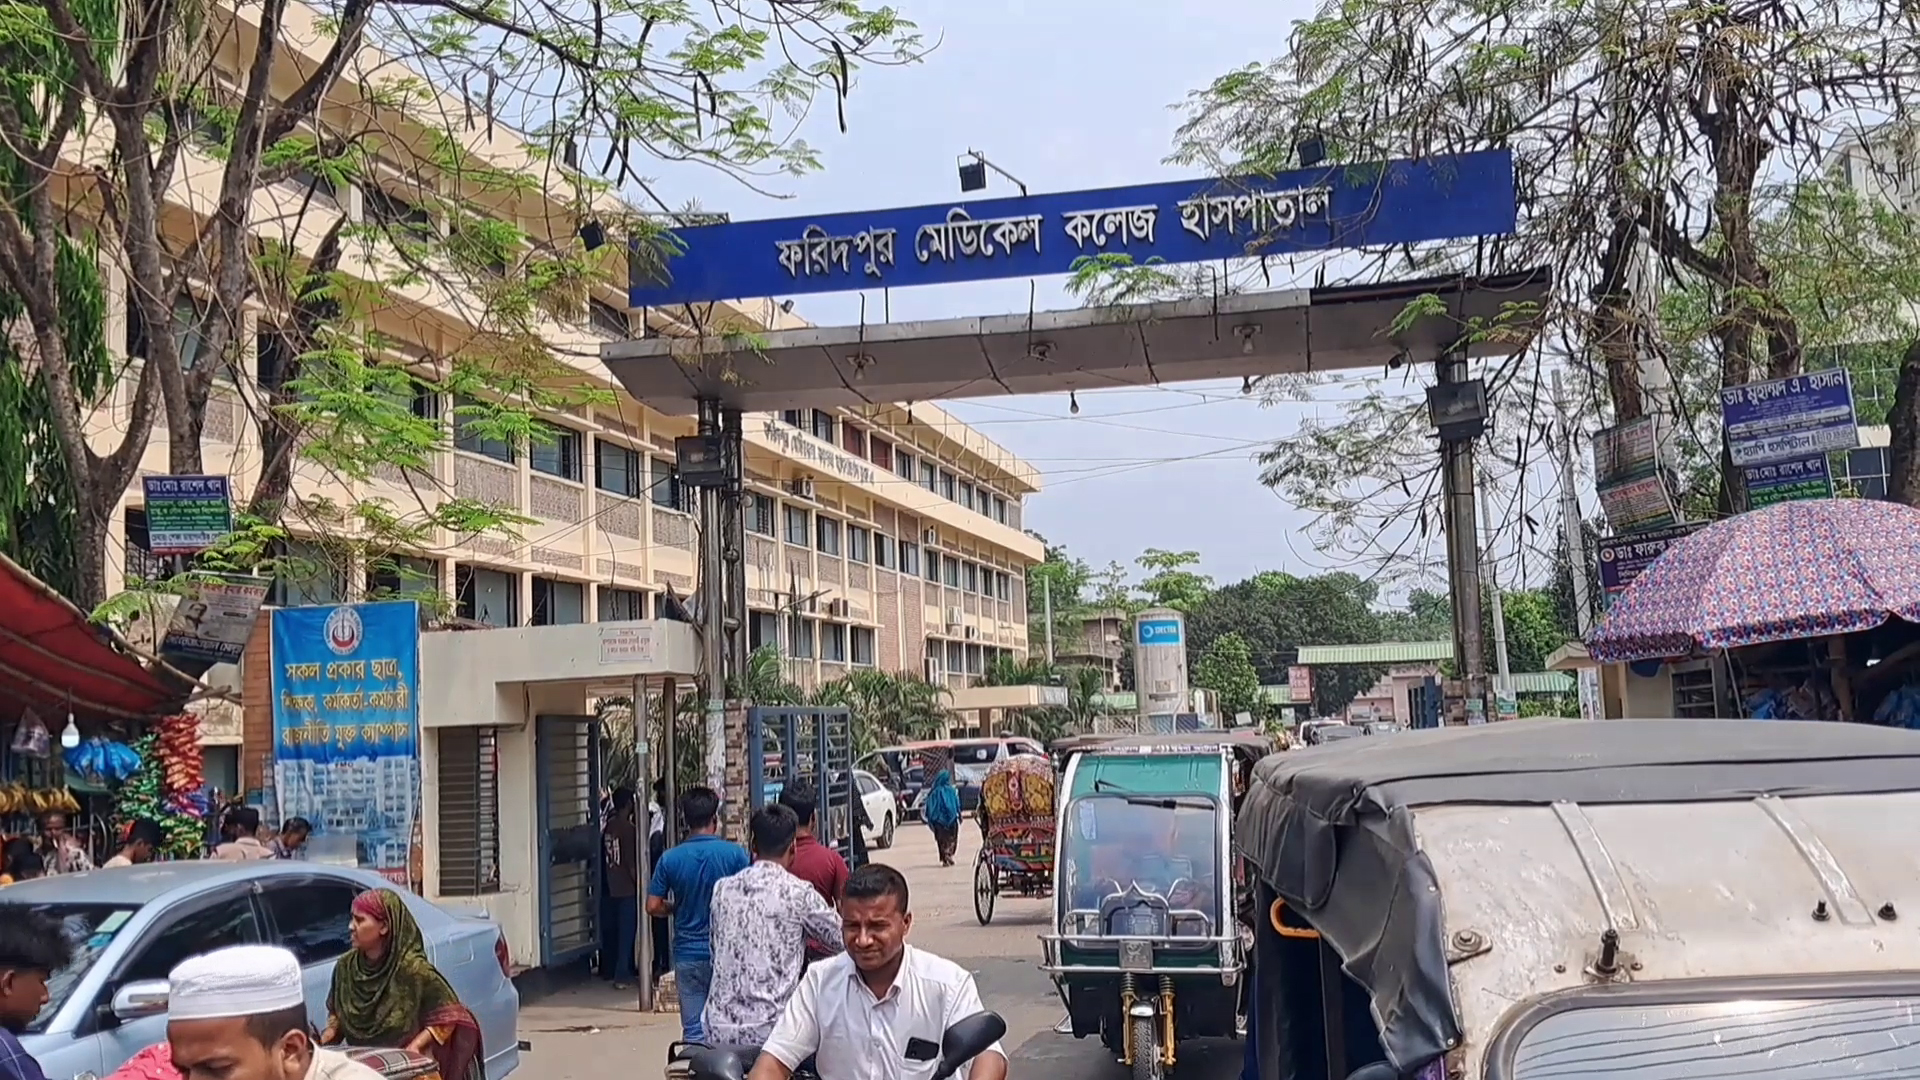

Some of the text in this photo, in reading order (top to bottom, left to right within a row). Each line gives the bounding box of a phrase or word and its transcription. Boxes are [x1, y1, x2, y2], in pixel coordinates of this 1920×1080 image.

[775, 185, 1334, 278] ফরিদপুর মেডিকেল কলেজ হাসপাতাল
[1722, 390, 1744, 405] ডাঃ
[1746, 379, 1787, 405] মুহাম্মদ
[1809, 369, 1845, 391] হাসান
[1615, 546, 1633, 559] ডাঃ
[285, 658, 403, 681] সকল প্রকার ছাত্র,
[282, 718, 409, 750] রাজনীতি মুক্ত ক্যাম্পাস
